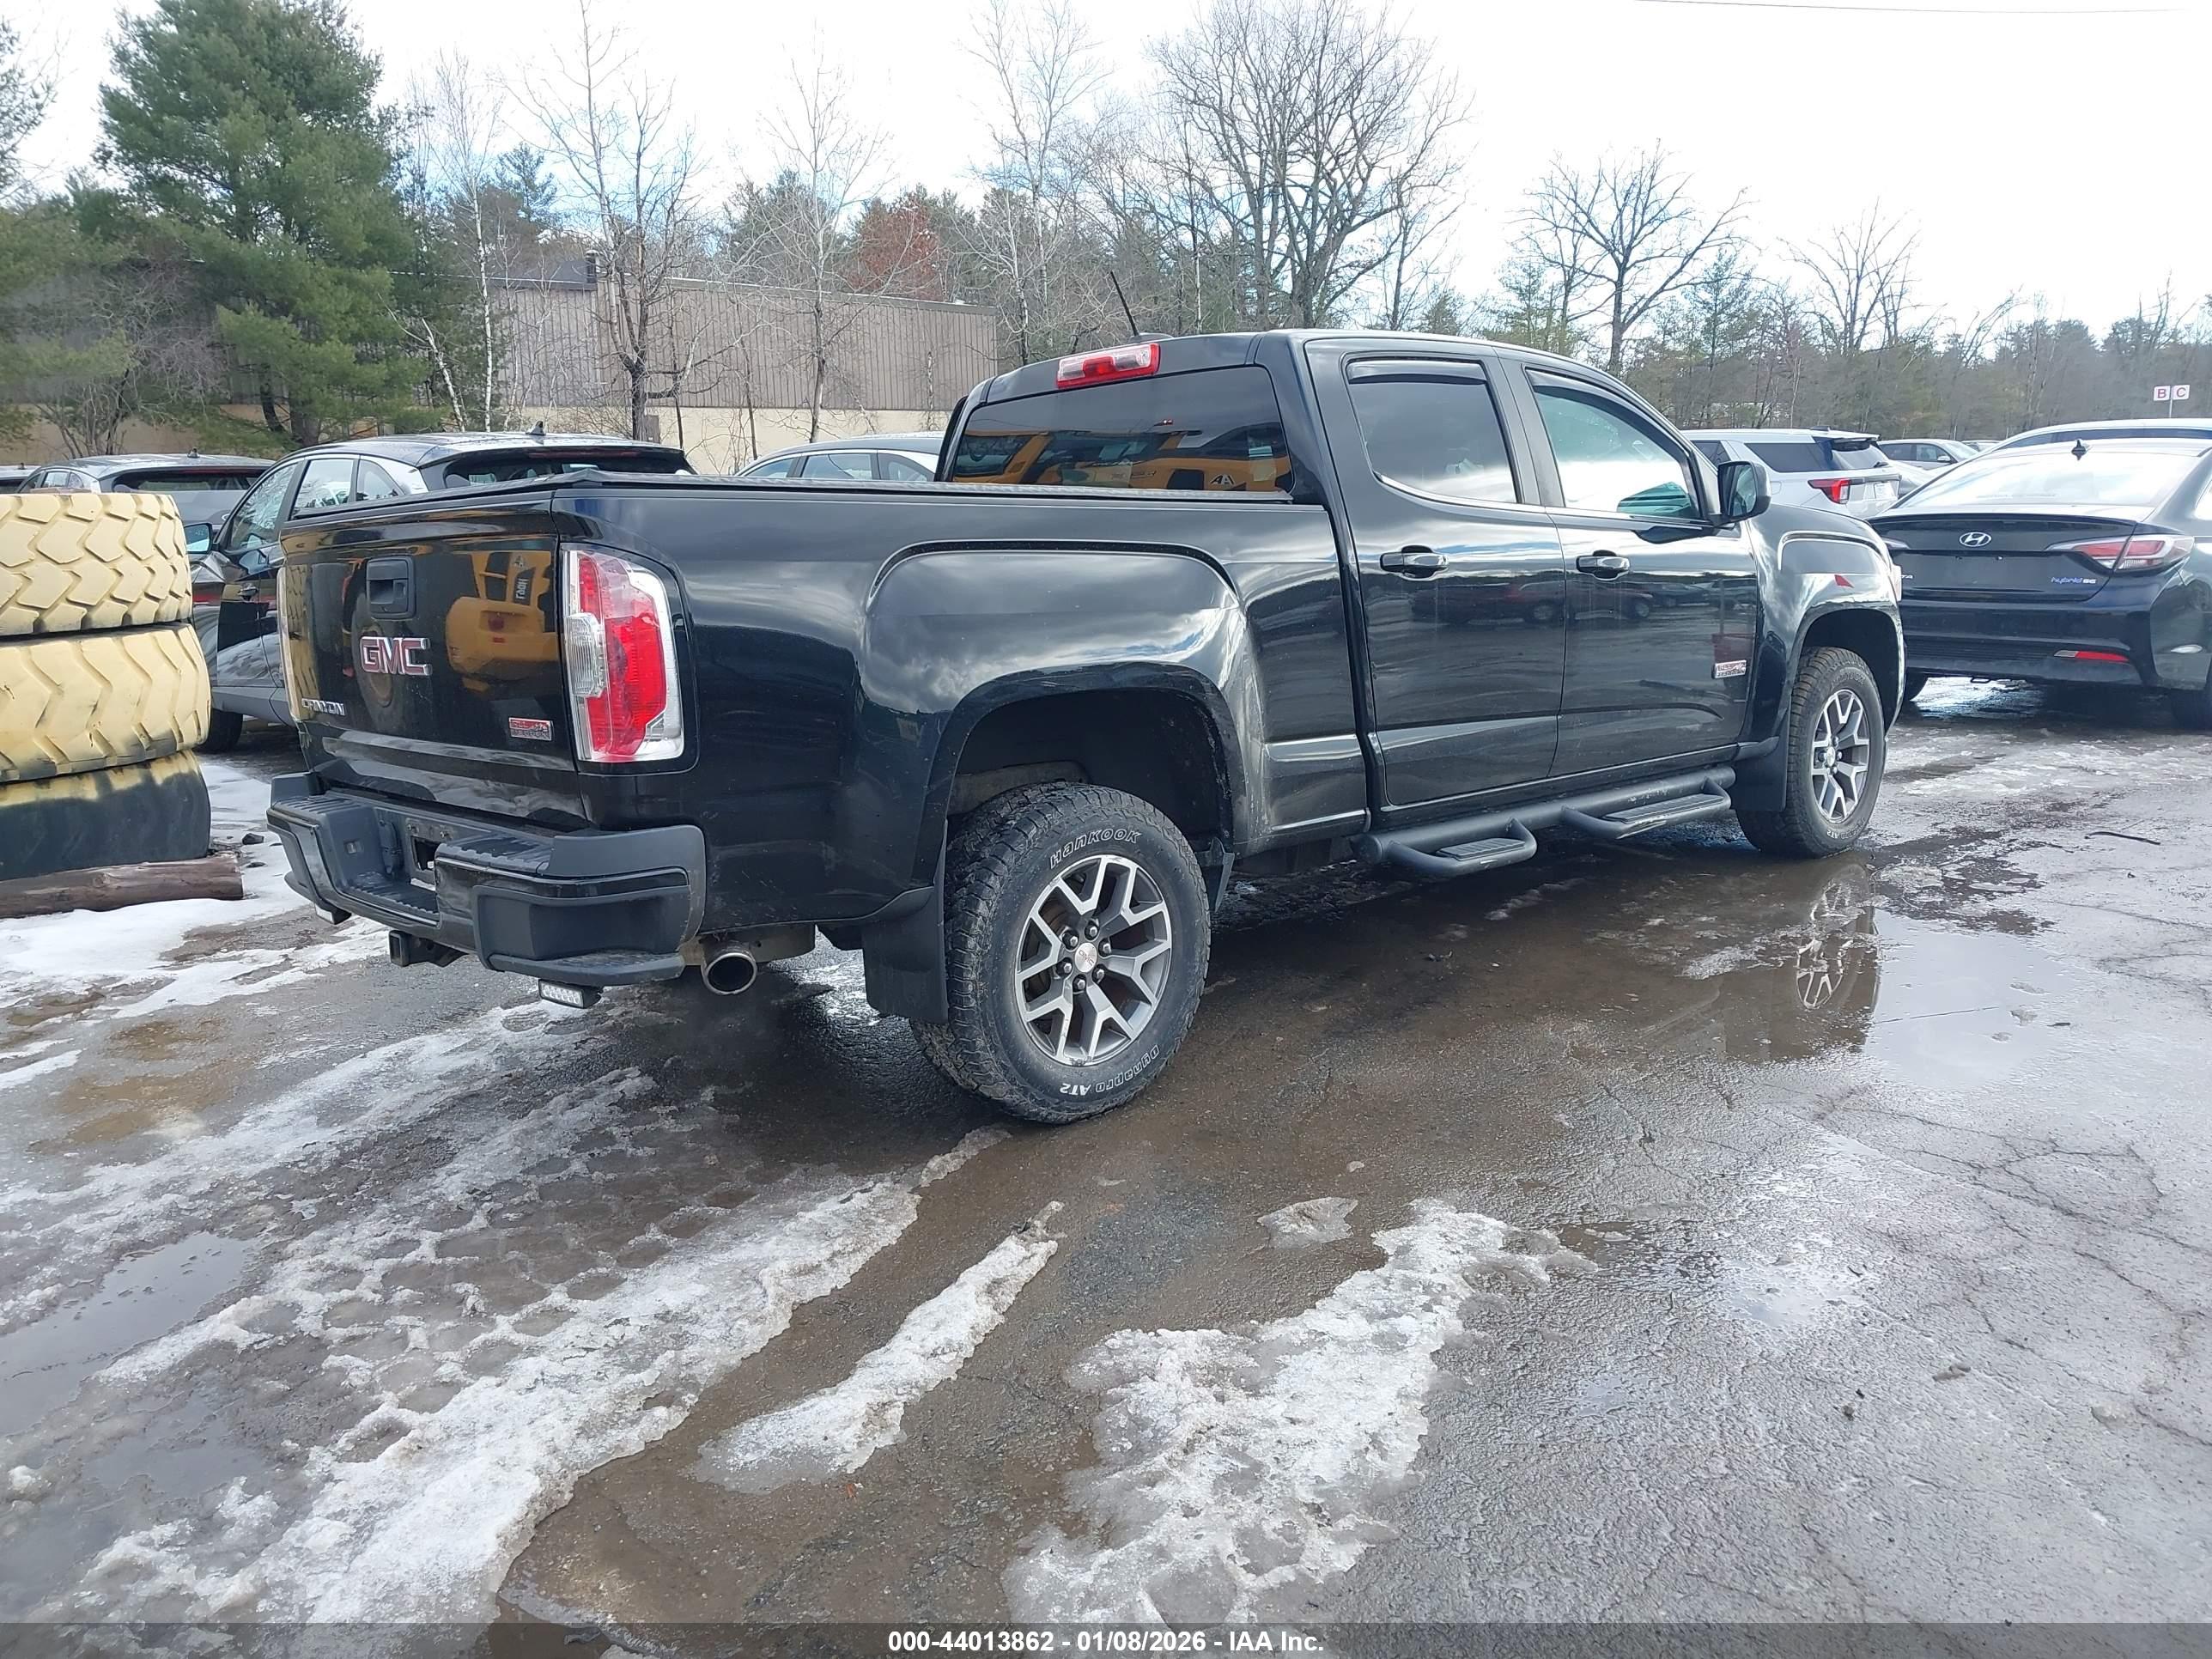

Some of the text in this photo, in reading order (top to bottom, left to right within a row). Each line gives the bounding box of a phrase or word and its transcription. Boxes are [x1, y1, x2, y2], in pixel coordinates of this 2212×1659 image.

[2157, 388, 2166, 398] B
[2176, 387, 2186, 398] C
[360, 636, 432, 676] GMC
[1059, 1082, 1091, 1096] AT2
